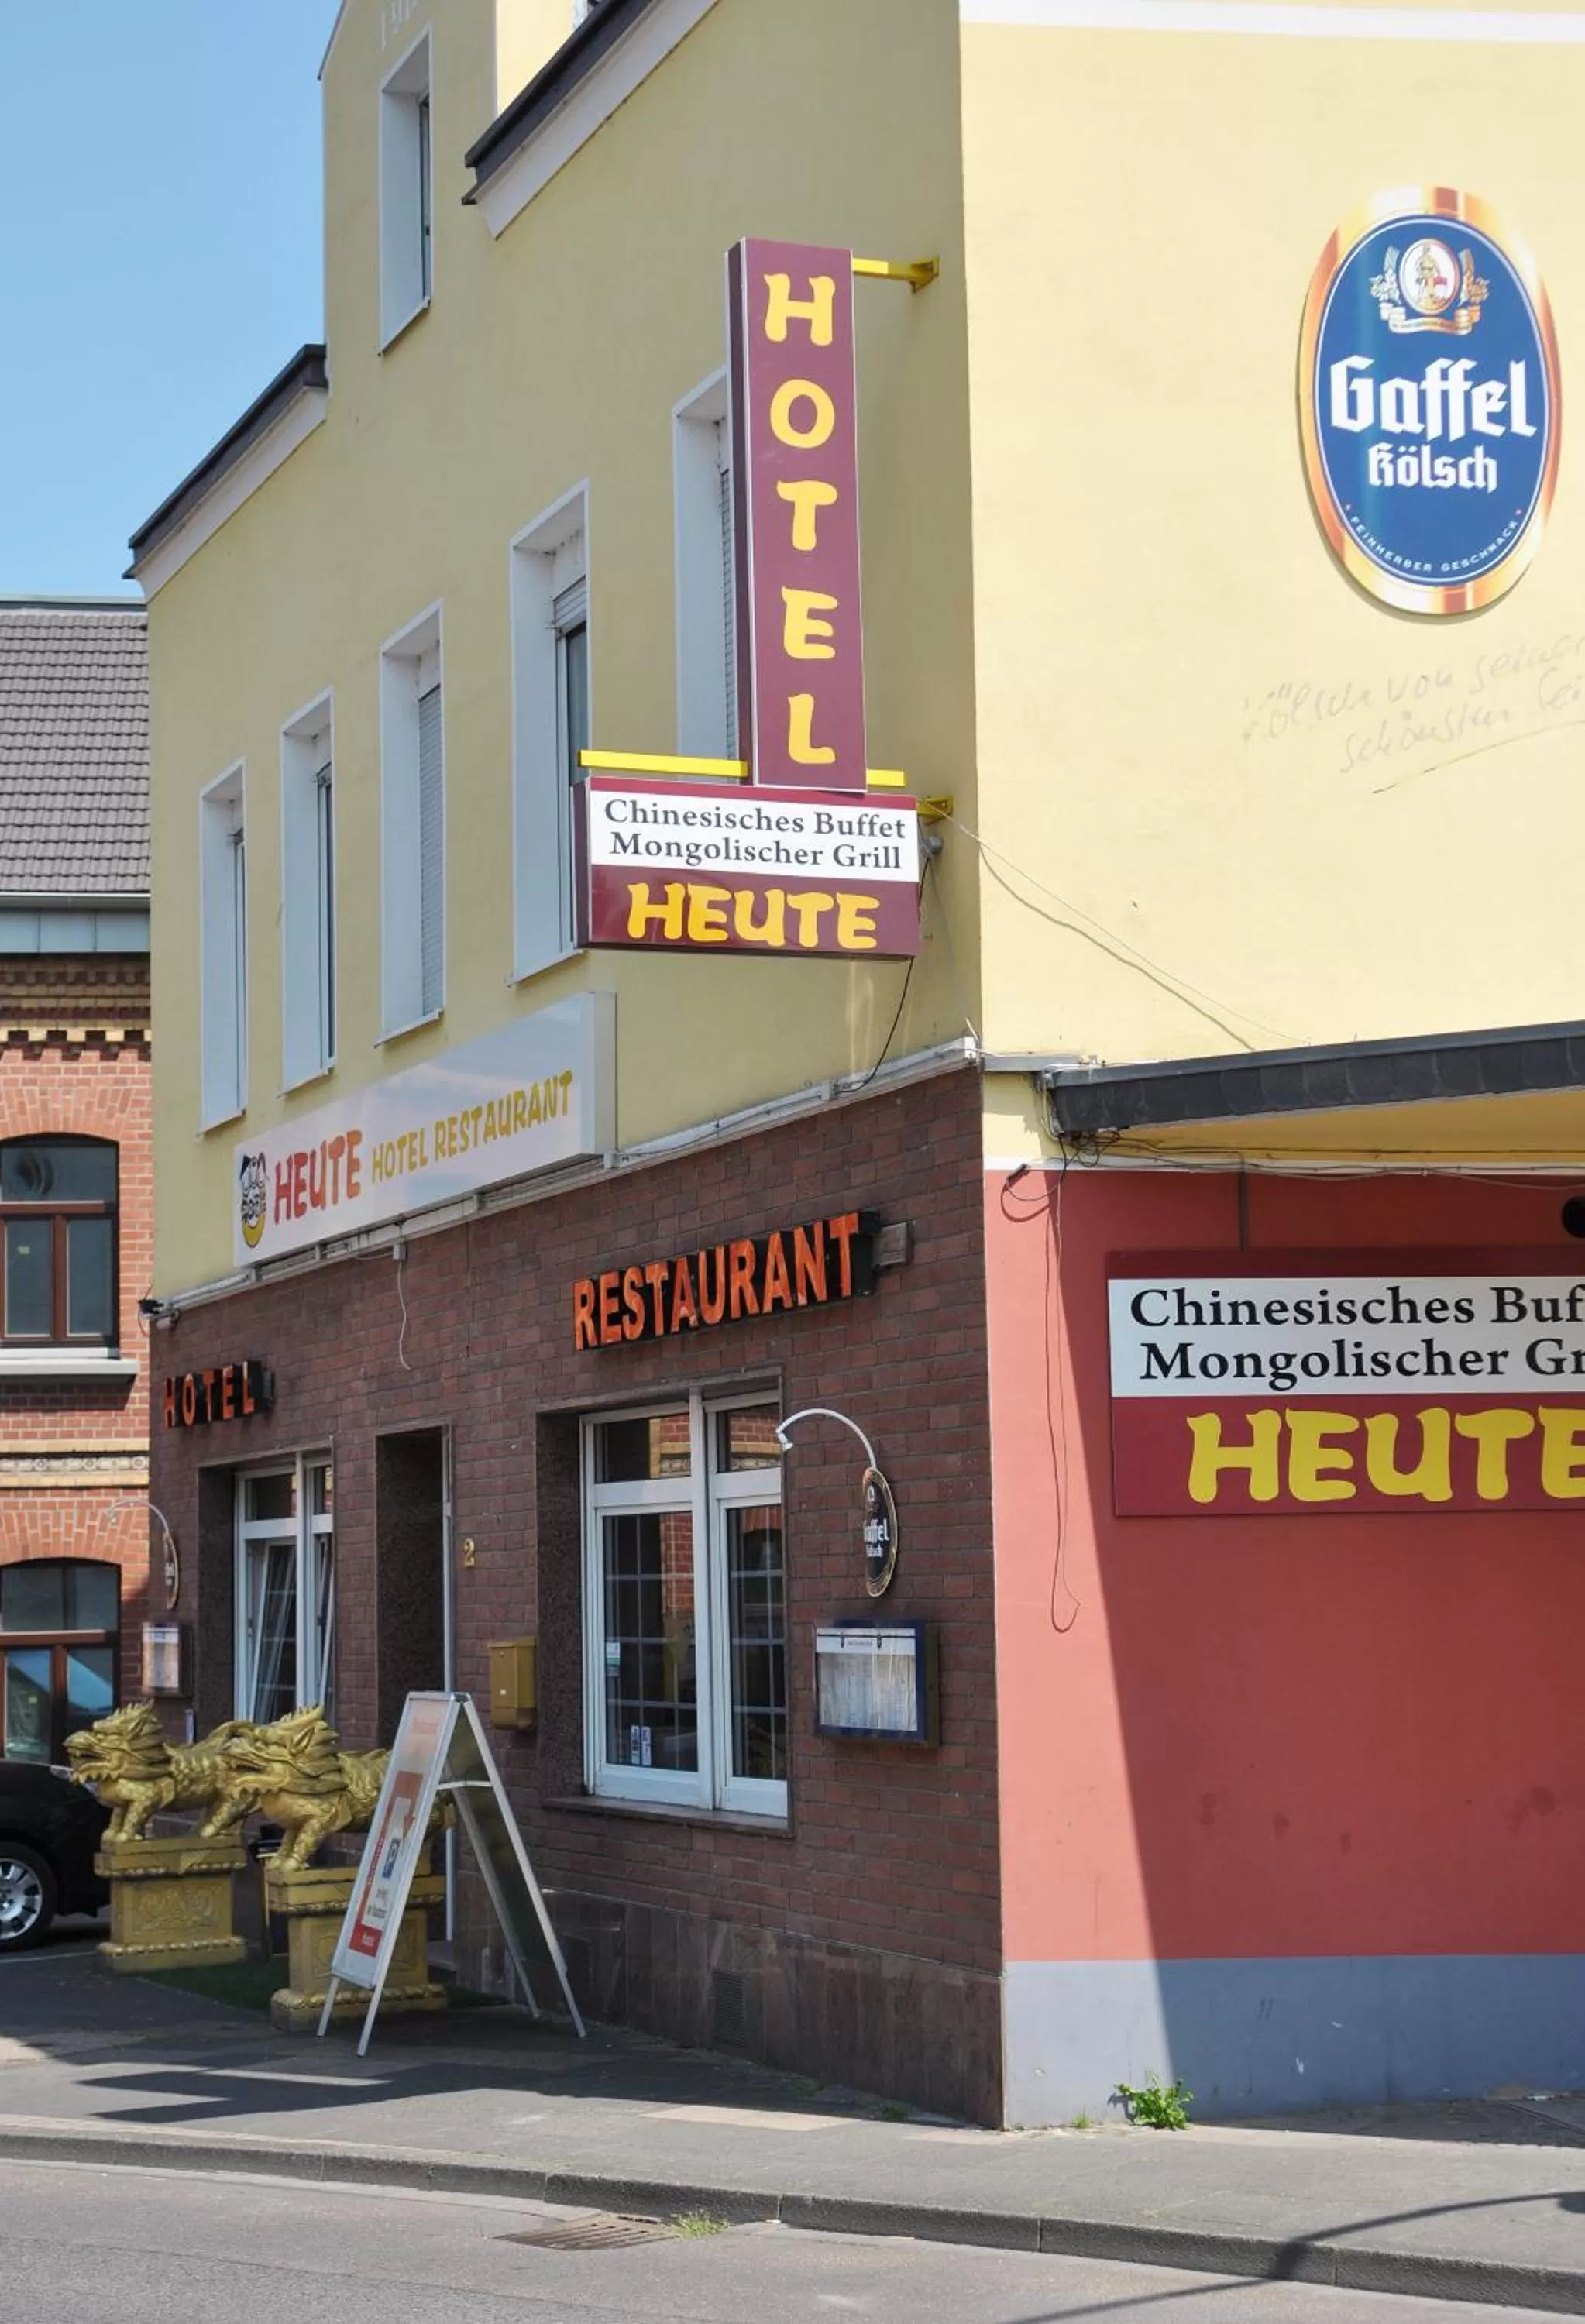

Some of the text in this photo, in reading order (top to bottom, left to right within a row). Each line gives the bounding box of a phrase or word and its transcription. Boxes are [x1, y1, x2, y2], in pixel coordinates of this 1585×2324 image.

[1329, 354, 1538, 443] Gaffel
[1367, 441, 1498, 493] Kölsch
[763, 272, 838, 765] HOTEL
[1350, 515, 1519, 572] FEINHERBER GESCHMACK
[604, 799, 906, 840] Chinesisches Buffet
[609, 831, 902, 869] Mongolischer Grill
[627, 882, 881, 951] HEUTE
[273, 1069, 574, 1226] HEUTE HOTEL RESTAURANT
[573, 1211, 860, 1351] RESTAURANT
[1129, 1284, 1585, 1328] Chinesisches Buf
[163, 1360, 255, 1431] HOTEL
[1139, 1338, 1510, 1393] Mongolischer
[1186, 1404, 1585, 1504] HEUTE
[464, 1538, 476, 1567] 2
